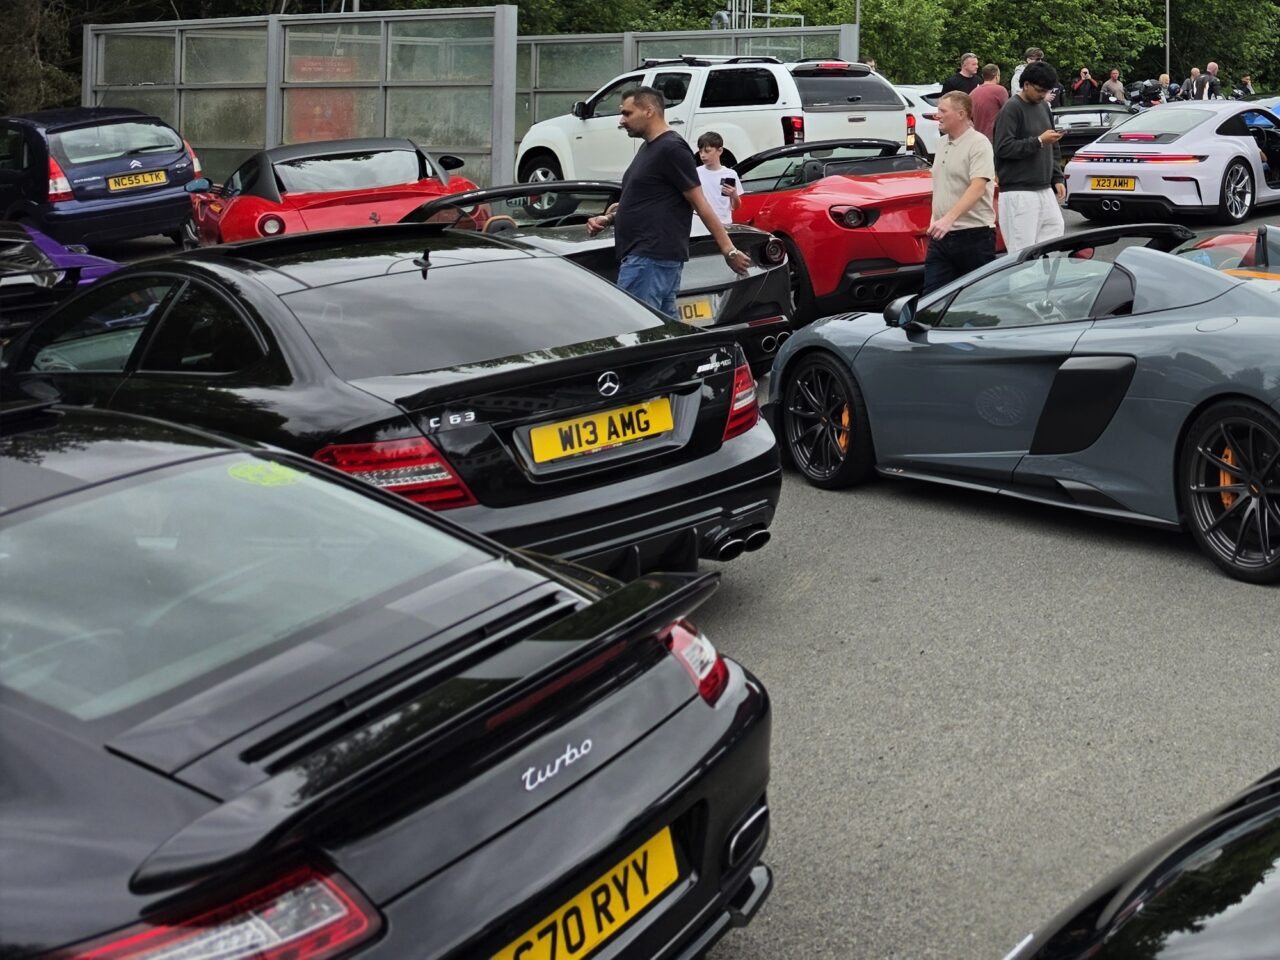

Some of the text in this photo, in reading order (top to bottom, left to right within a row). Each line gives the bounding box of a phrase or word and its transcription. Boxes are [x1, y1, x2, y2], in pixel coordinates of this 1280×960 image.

[114, 172, 162, 187] NC55 LTK
[1096, 178, 1111, 188] X23
[430, 411, 475, 428] C 63
[559, 408, 650, 451] W13 AMG
[521, 738, 592, 791] turbo
[590, 850, 649, 934] RYY
